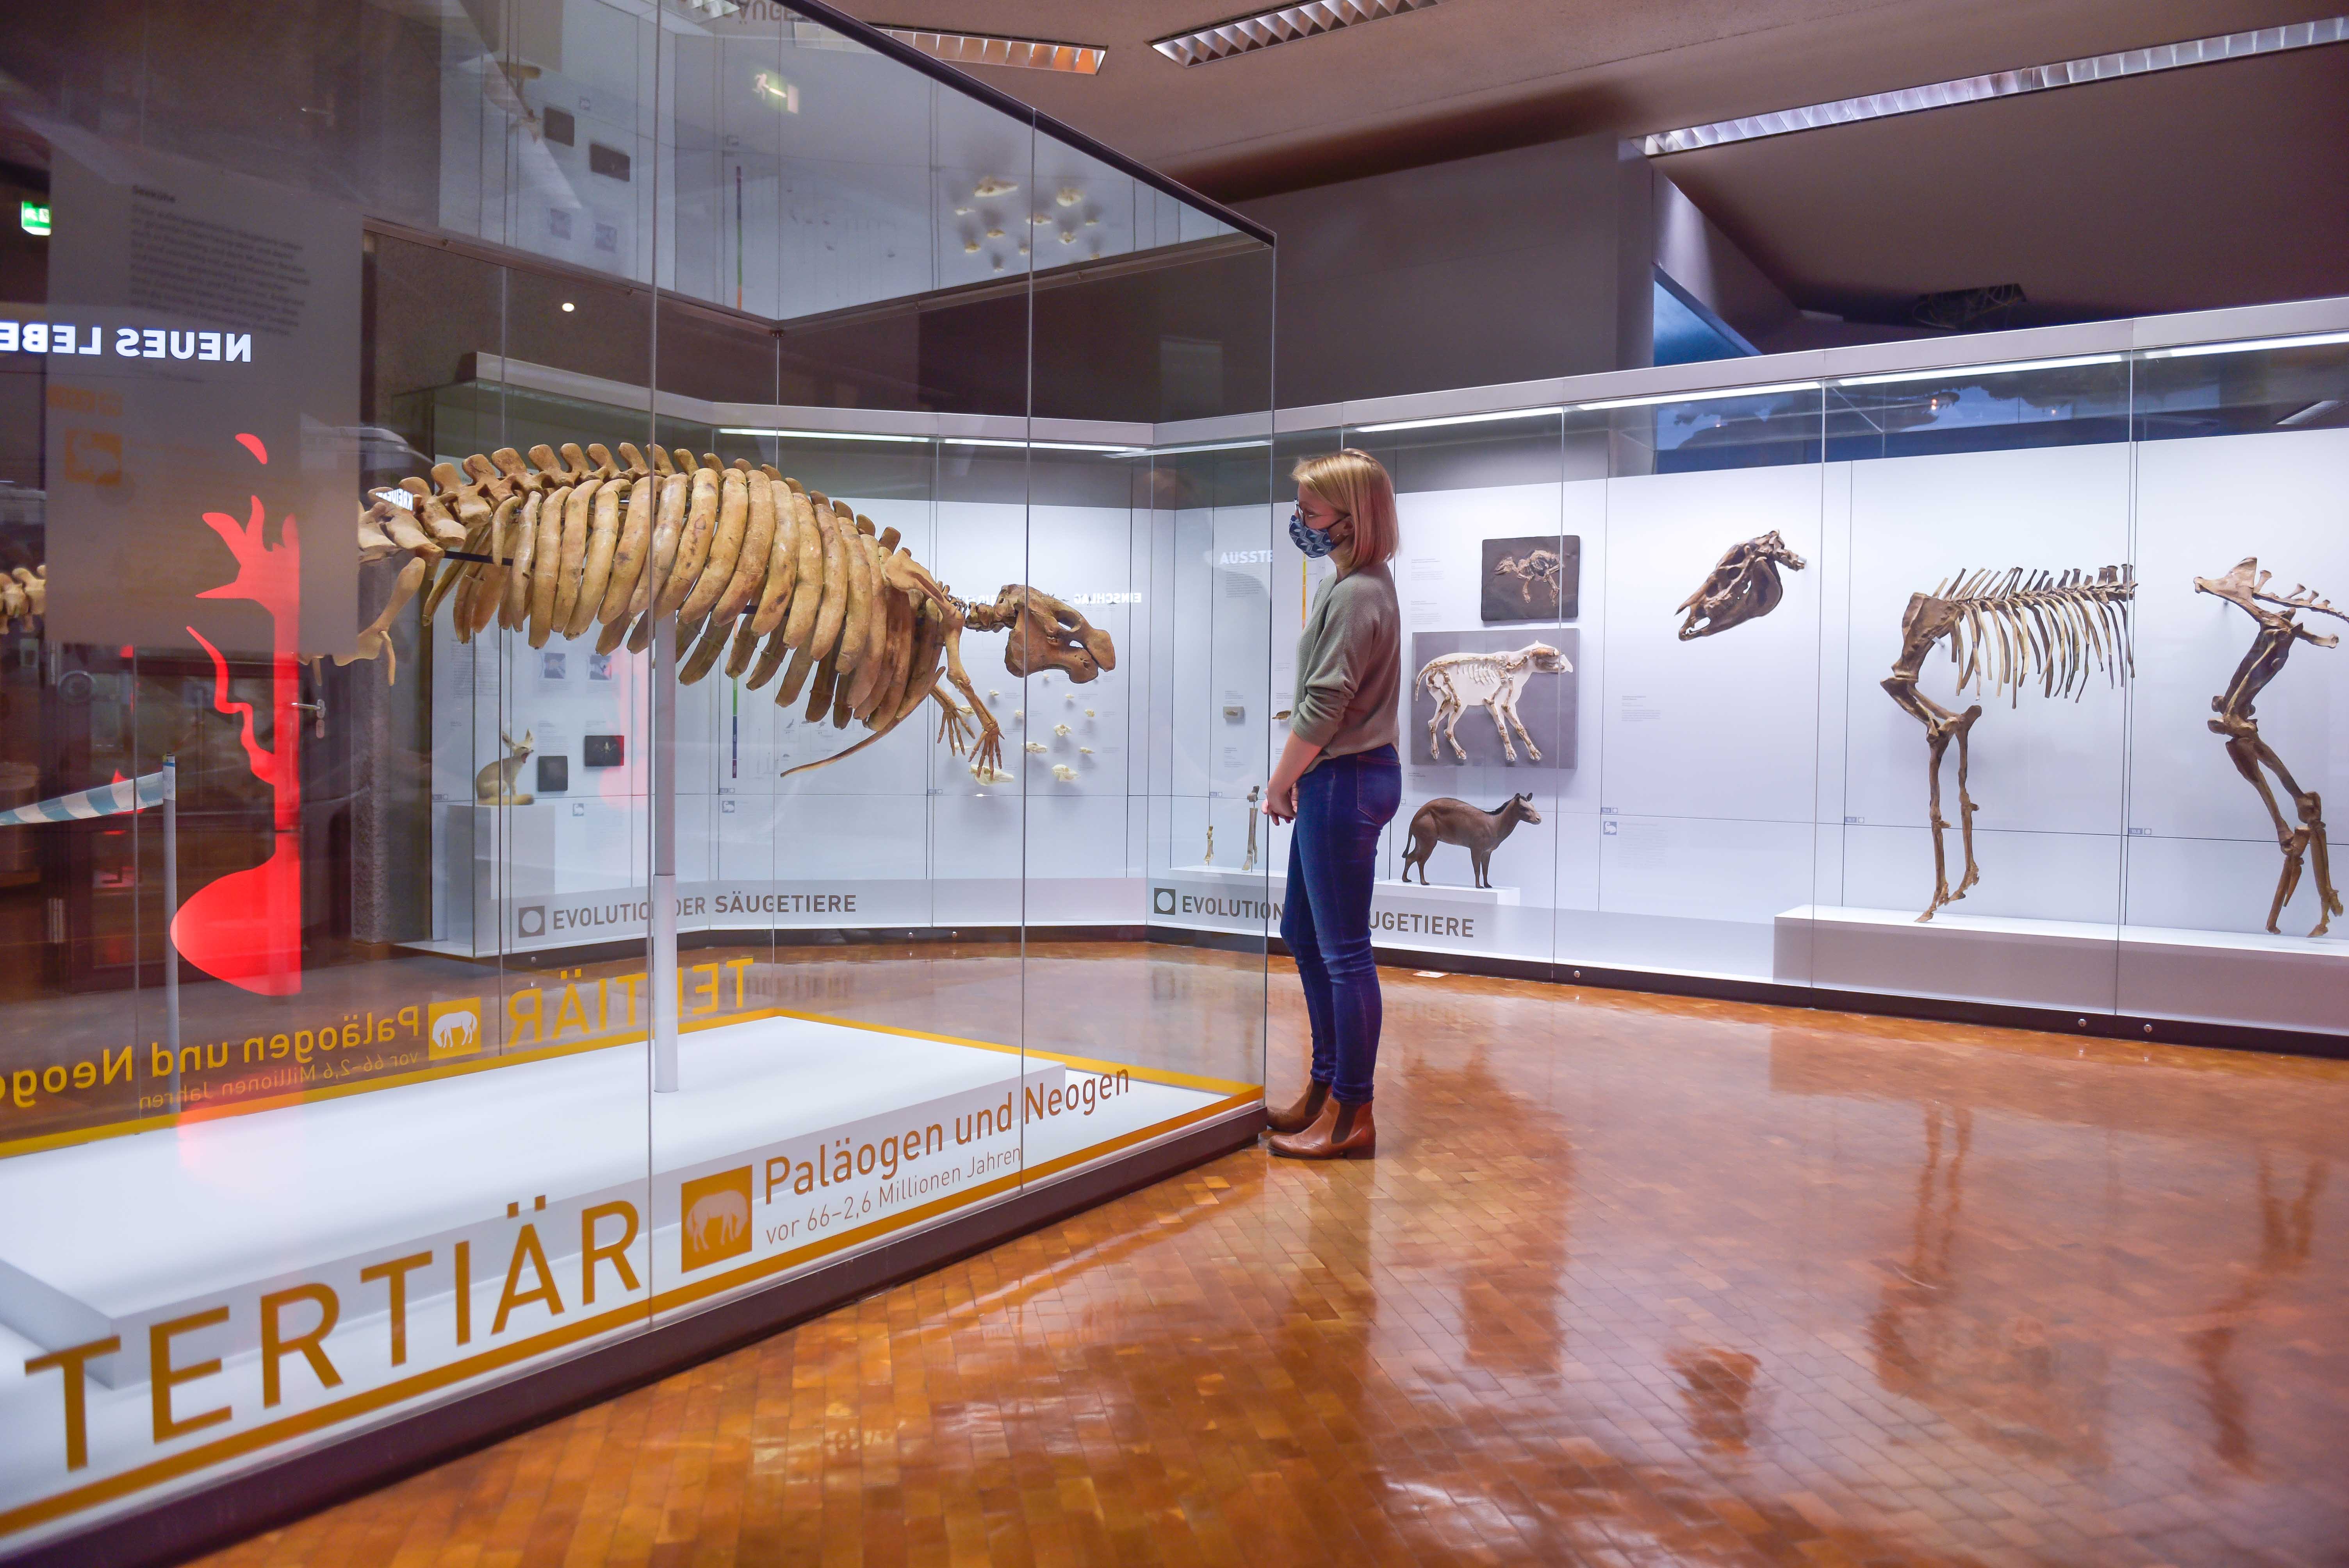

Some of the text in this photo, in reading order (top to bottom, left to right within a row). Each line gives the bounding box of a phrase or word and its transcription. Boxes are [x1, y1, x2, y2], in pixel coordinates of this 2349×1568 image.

[553, 902, 653, 930] EVOLUTIO
[715, 891, 856, 913] SÄUGETIERE
[1182, 895, 1285, 920] EVOLUTION
[1369, 911, 1474, 938] UGETIERE
[766, 1068, 1130, 1204] Paläogen und Neogen
[766, 1220, 800, 1245] vor
[879, 1166, 961, 1208] Millionen
[967, 1147, 1021, 1178] Jahren
[25, 1194, 641, 1471] TERTIÄR
